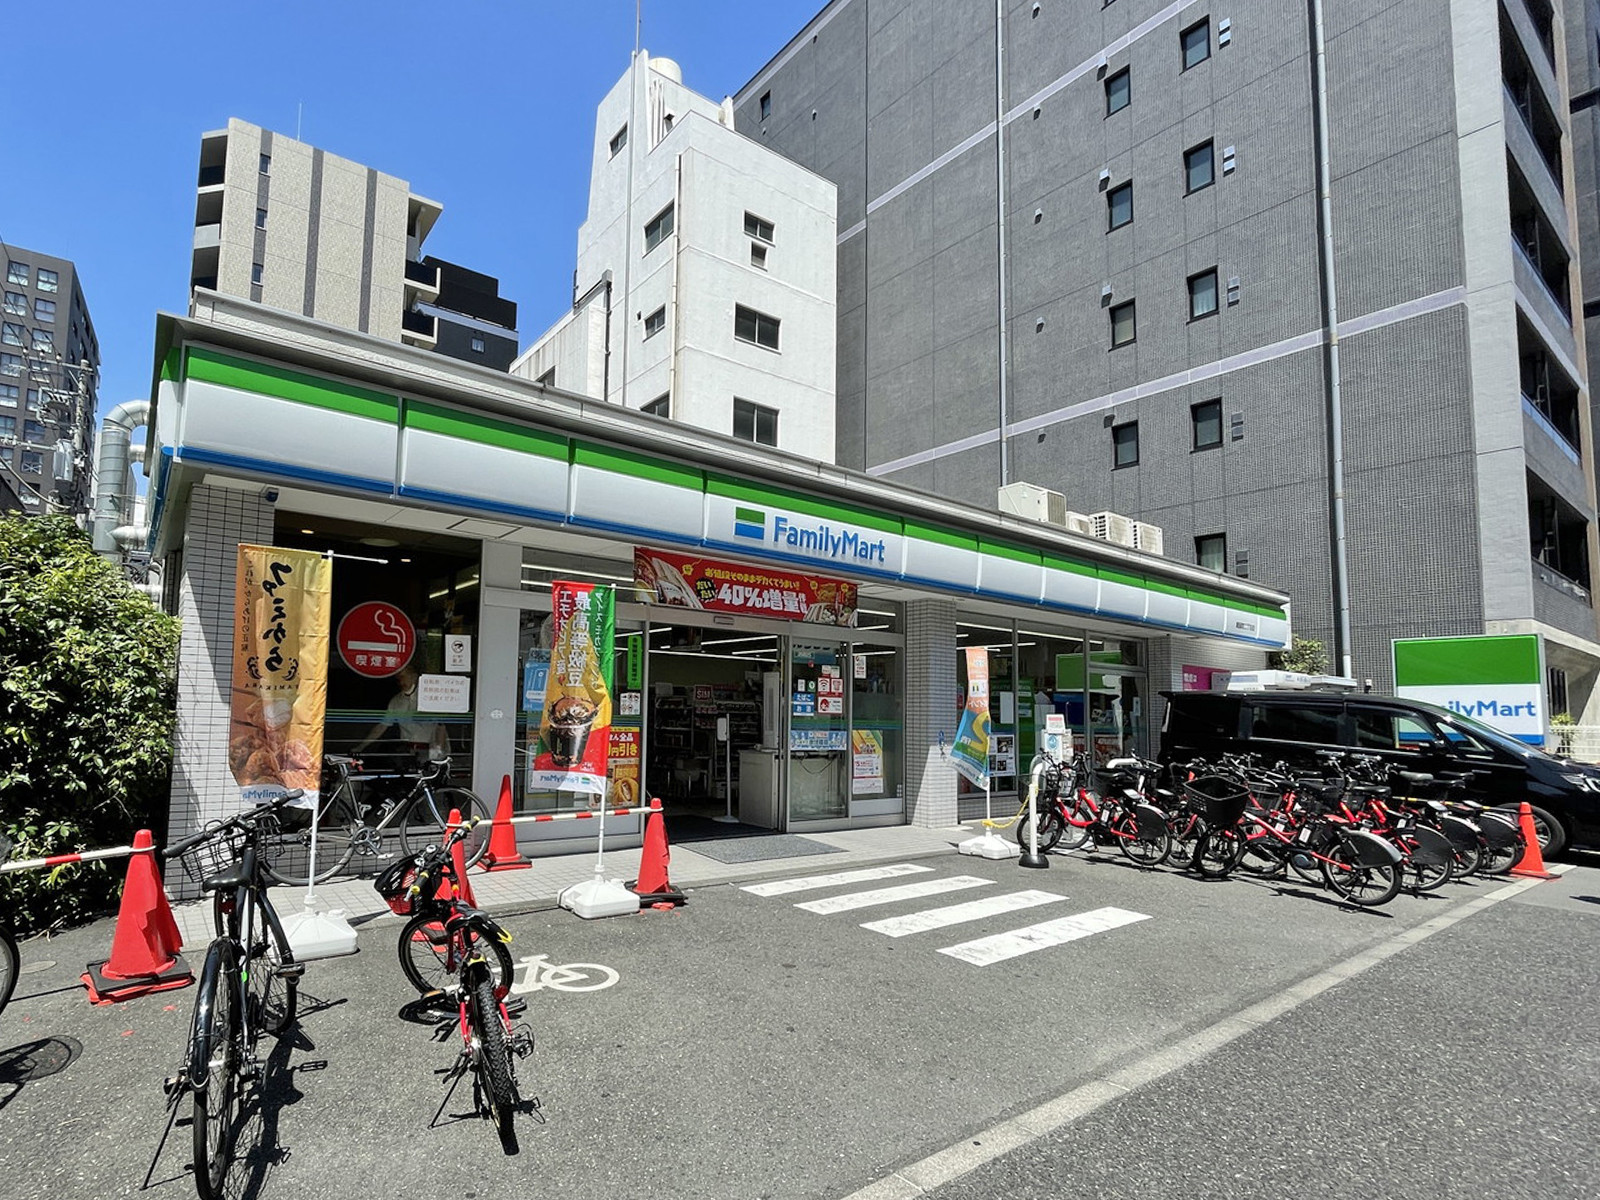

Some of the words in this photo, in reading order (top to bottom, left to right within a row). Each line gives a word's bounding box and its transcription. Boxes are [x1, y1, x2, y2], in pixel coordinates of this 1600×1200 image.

[773, 515, 885, 562] FamilyMart
[718, 583, 800, 613] 40%増量
[355, 654, 398, 667] 喫煙室
[796, 693, 811, 701] たばこ
[608, 742, 638, 757] 円引き
